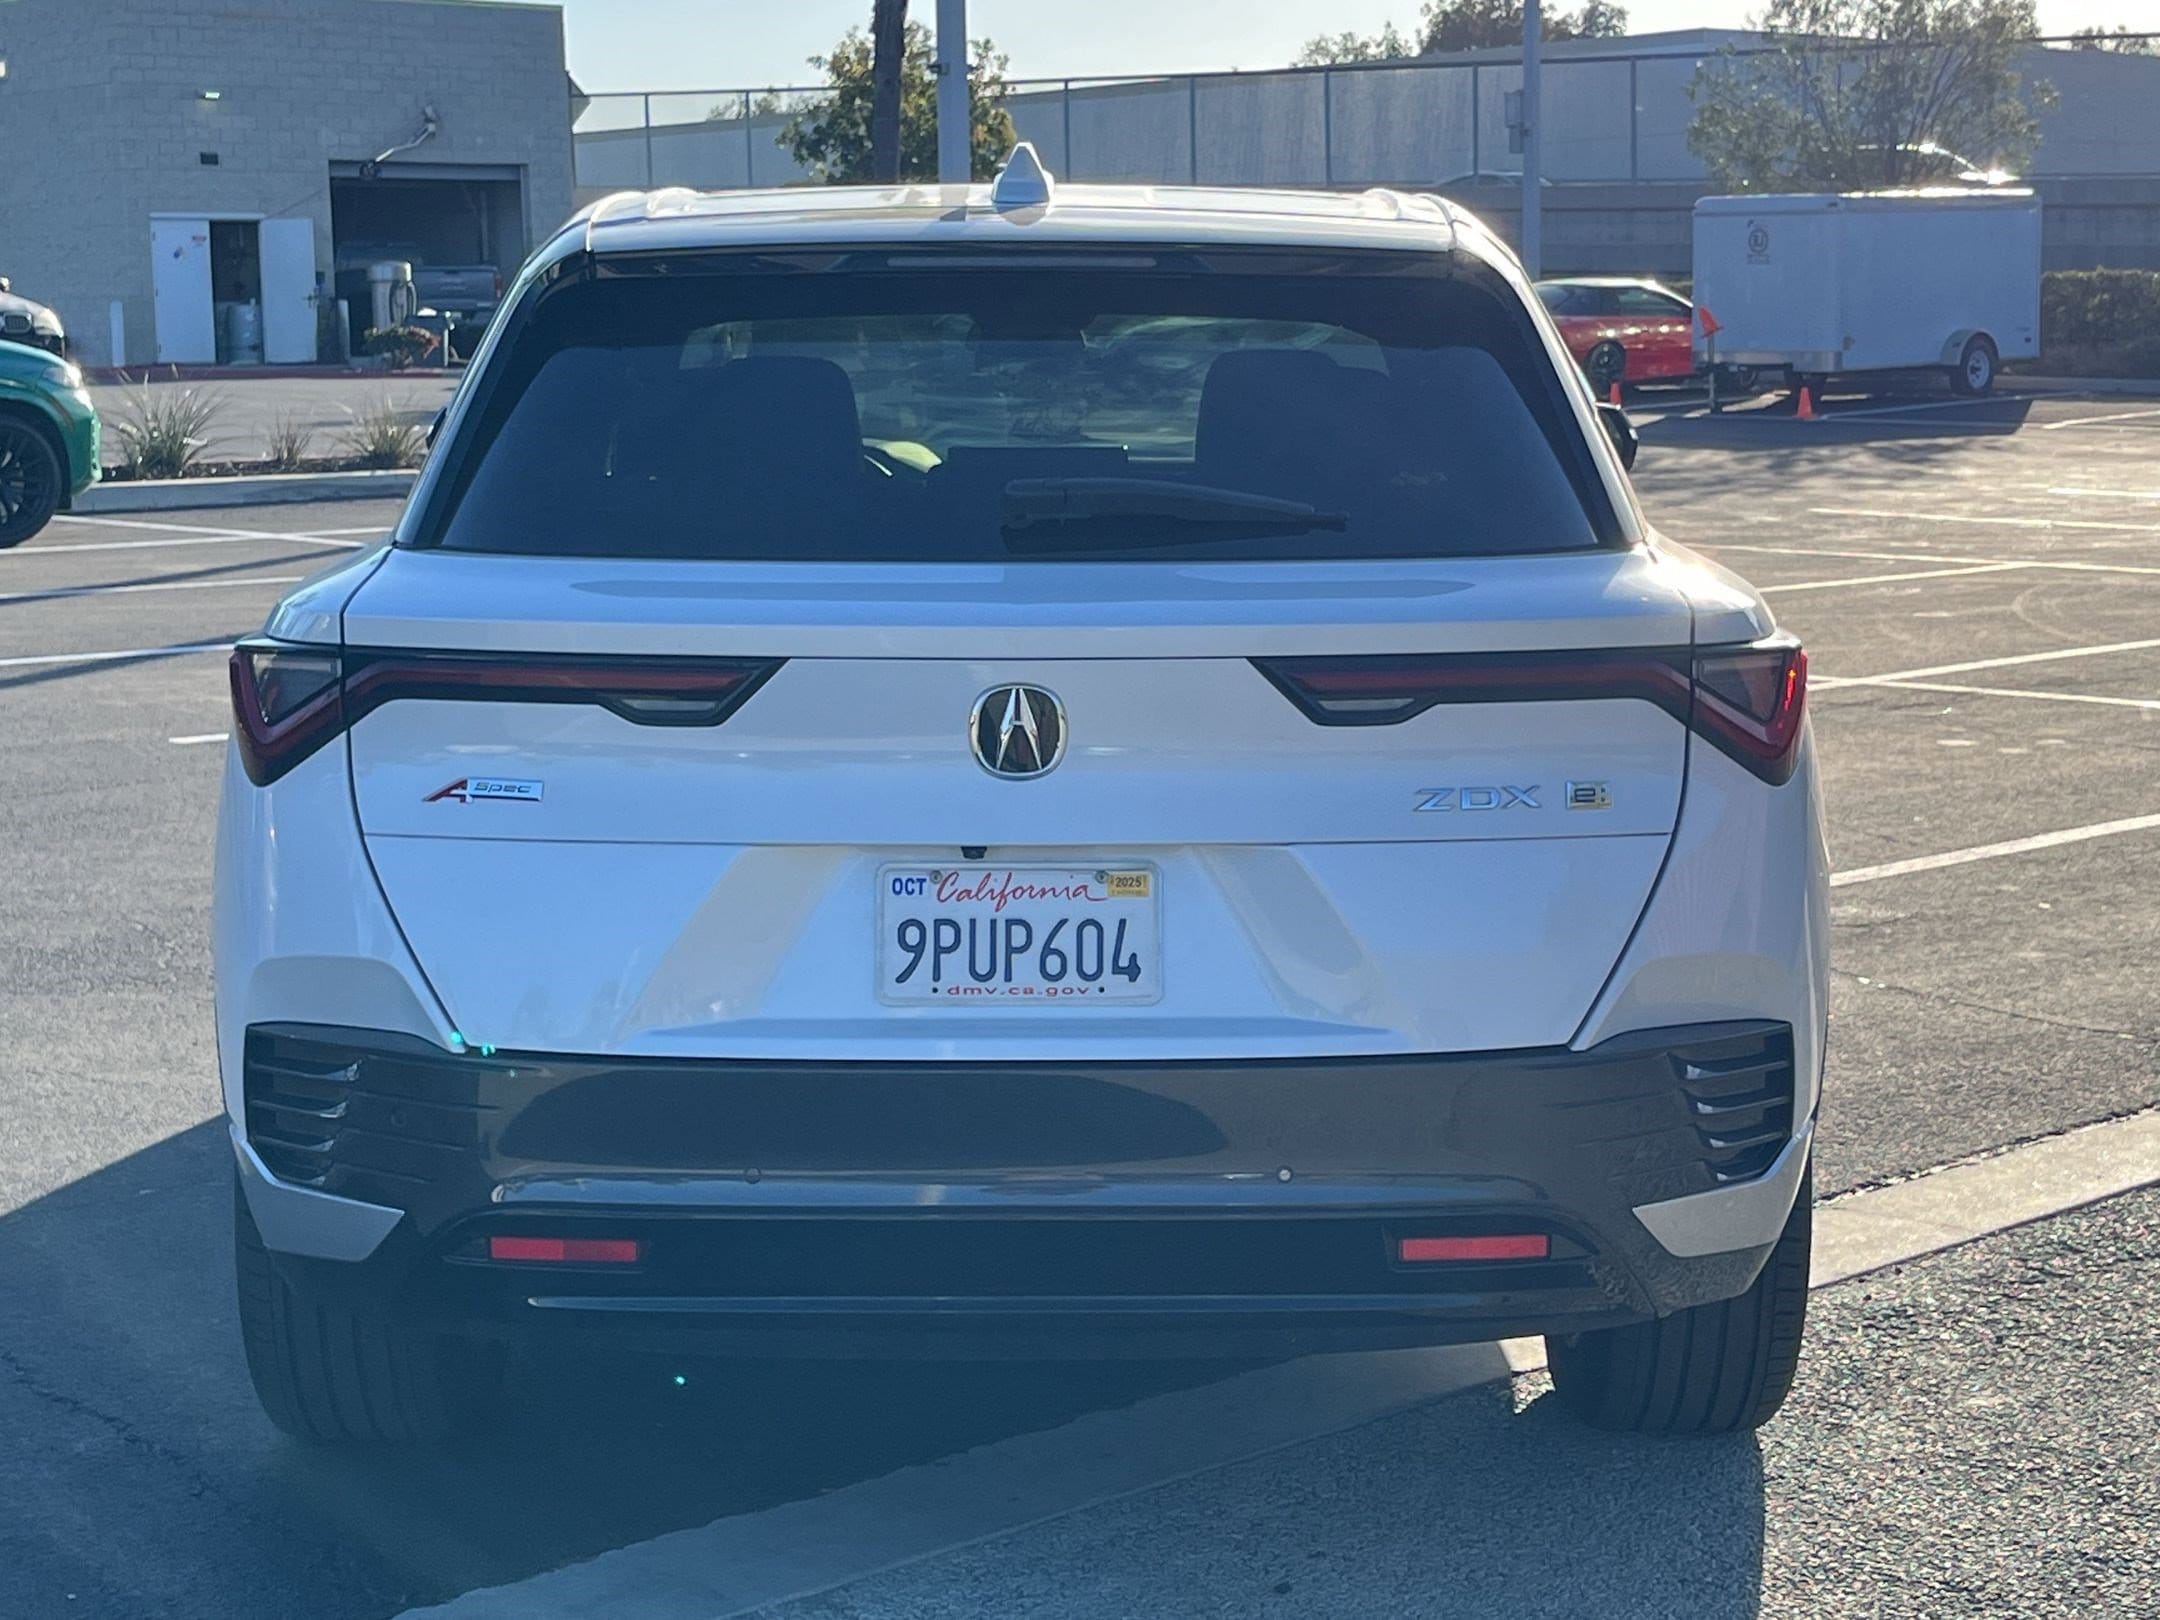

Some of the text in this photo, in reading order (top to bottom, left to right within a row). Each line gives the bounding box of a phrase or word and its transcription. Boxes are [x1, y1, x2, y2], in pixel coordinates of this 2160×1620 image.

[1413, 785, 1542, 812] ZDX
[892, 877, 927, 896] OCT
[936, 871, 1108, 912] California
[1115, 876, 1142, 888] 2025
[895, 918, 1141, 984] 9PUP604
[947, 985, 1089, 997] dmv.ca.gov
